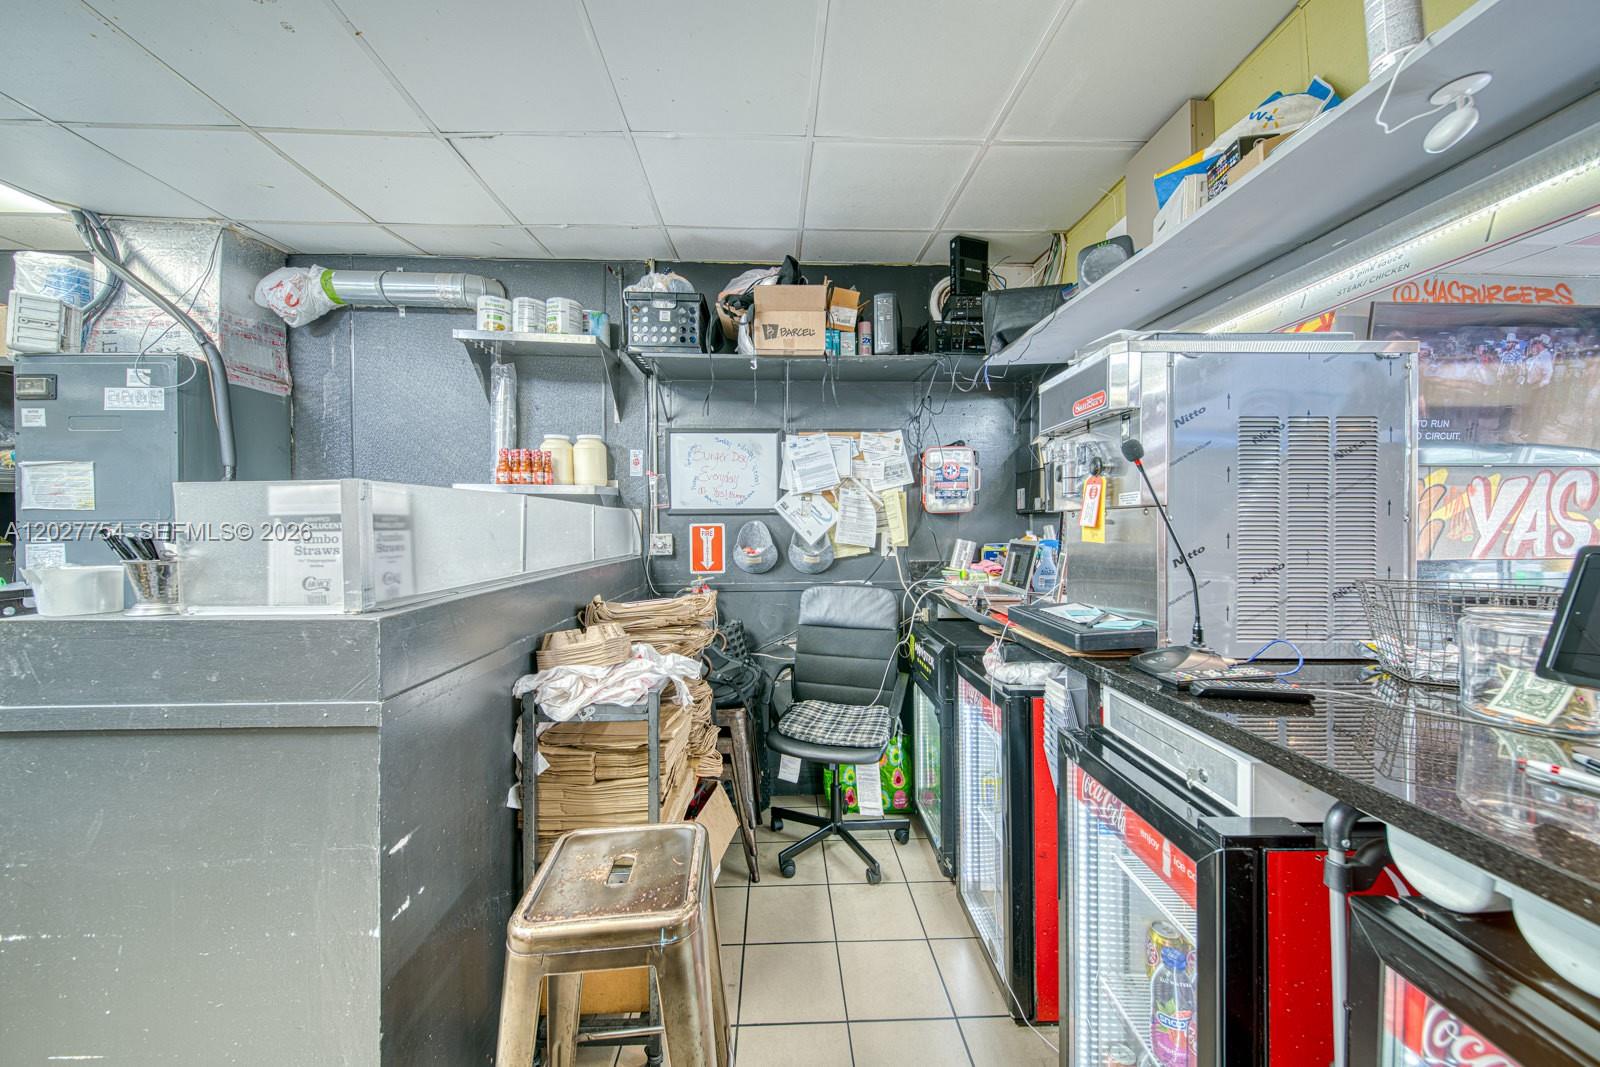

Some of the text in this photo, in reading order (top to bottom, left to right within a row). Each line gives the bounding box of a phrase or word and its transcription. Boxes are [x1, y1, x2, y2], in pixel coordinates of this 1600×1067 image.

[1369, 262, 1411, 283] CHICKEN
[1174, 406, 1207, 429] Nitto
[1430, 419, 1450, 428] RUN
[1252, 422, 1286, 445] Nitto
[1425, 432, 1461, 440] CIRCUIT.
[1466, 467, 1599, 560] YAS
[294, 545, 340, 556] Straws
[1172, 545, 1206, 568] Ntto
[1139, 828, 1160, 851] enjoy
